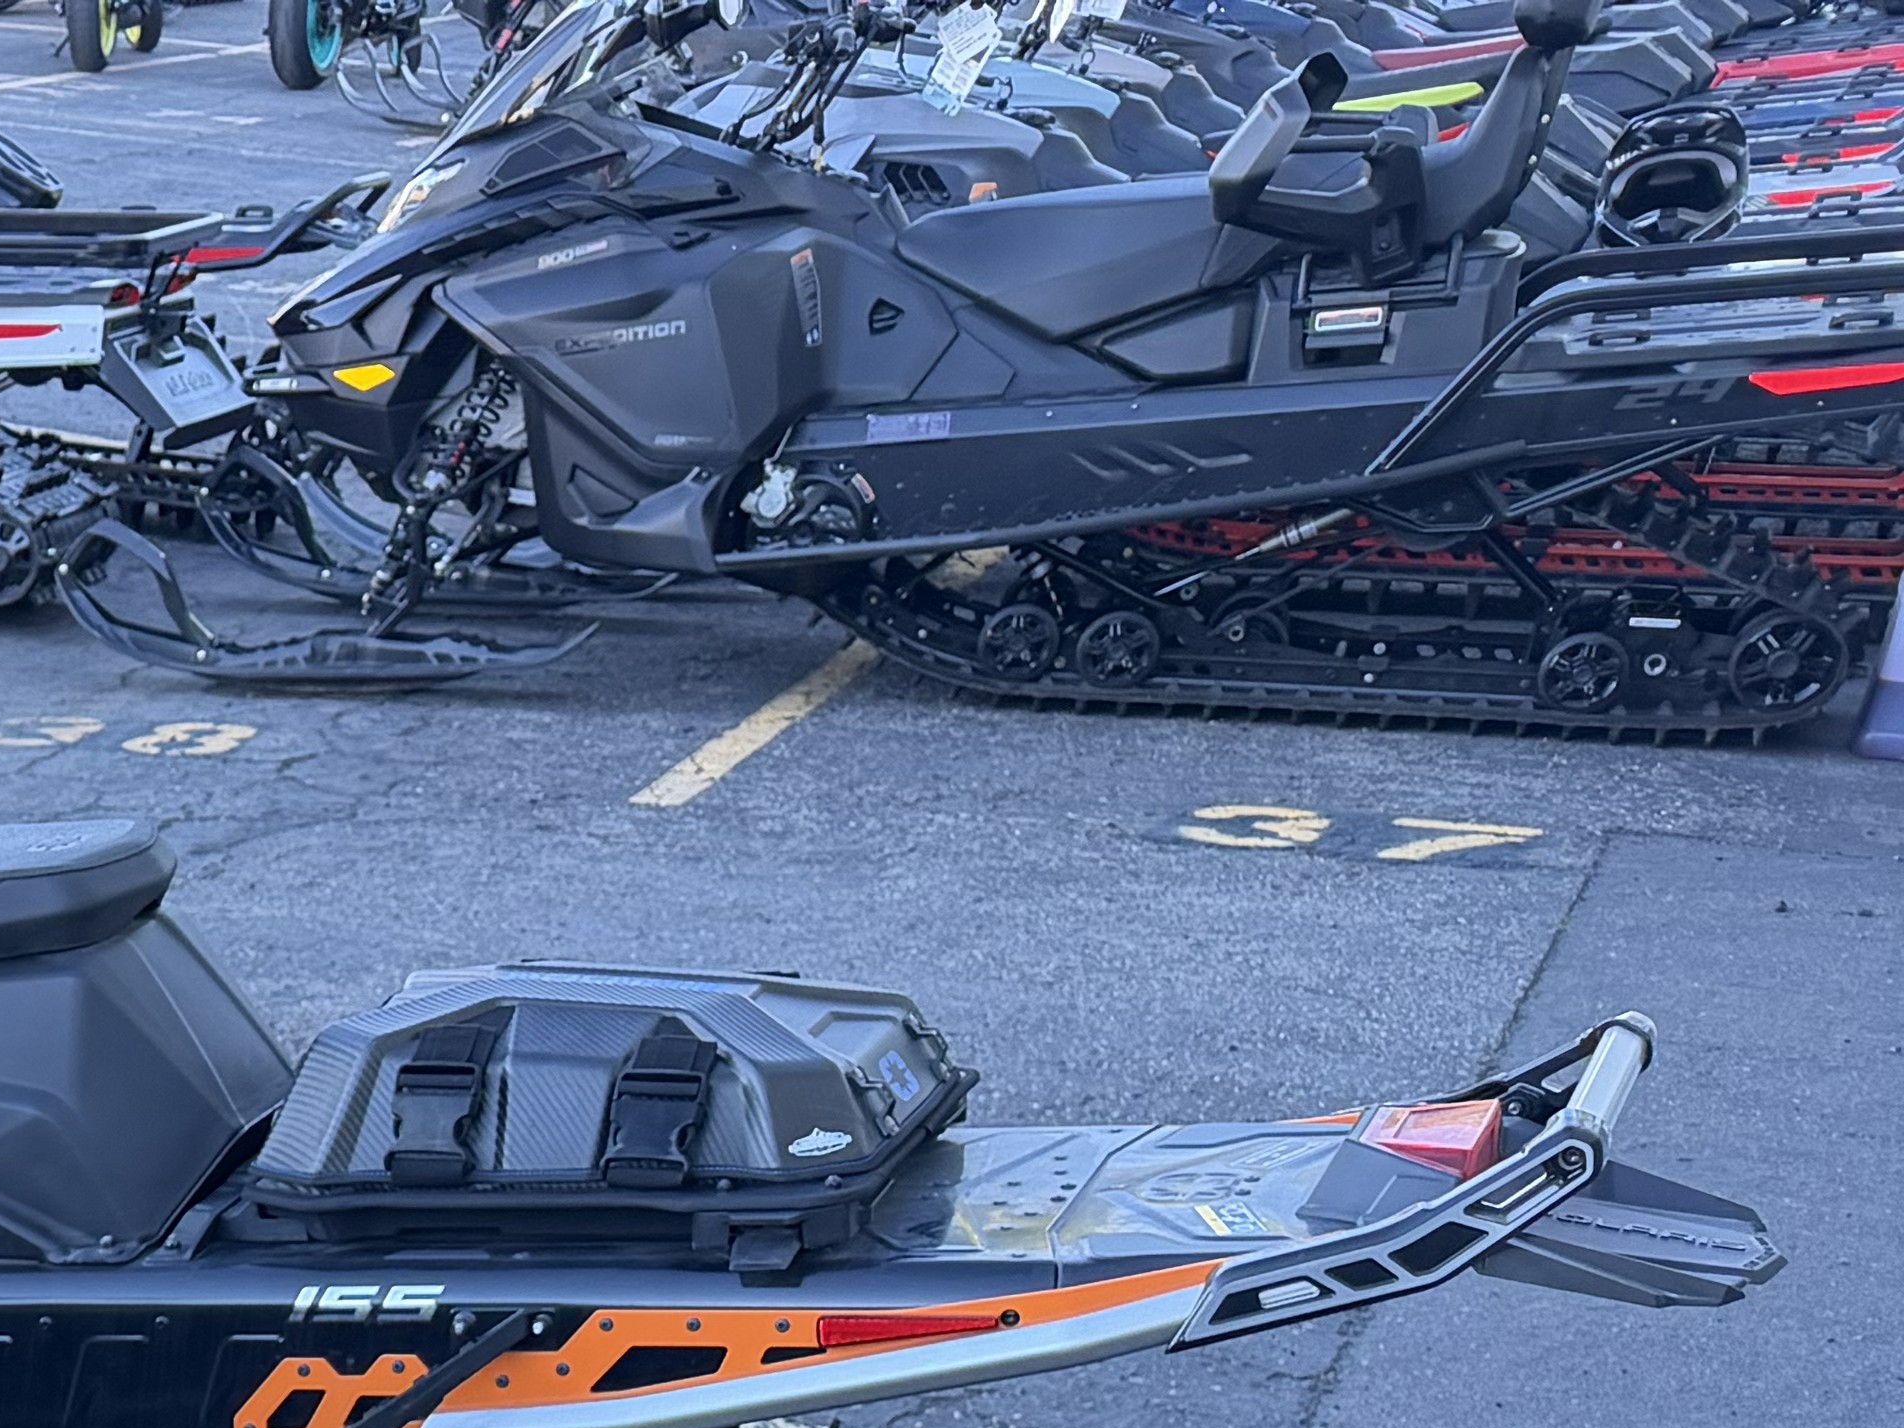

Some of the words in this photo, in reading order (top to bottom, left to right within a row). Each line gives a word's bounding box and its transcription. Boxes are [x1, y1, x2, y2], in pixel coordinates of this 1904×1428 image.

[1613, 377, 1738, 411] 24
[1177, 804, 1547, 862] 37
[1544, 1212, 1748, 1252] OLARIS
[288, 1284, 446, 1323] 155
